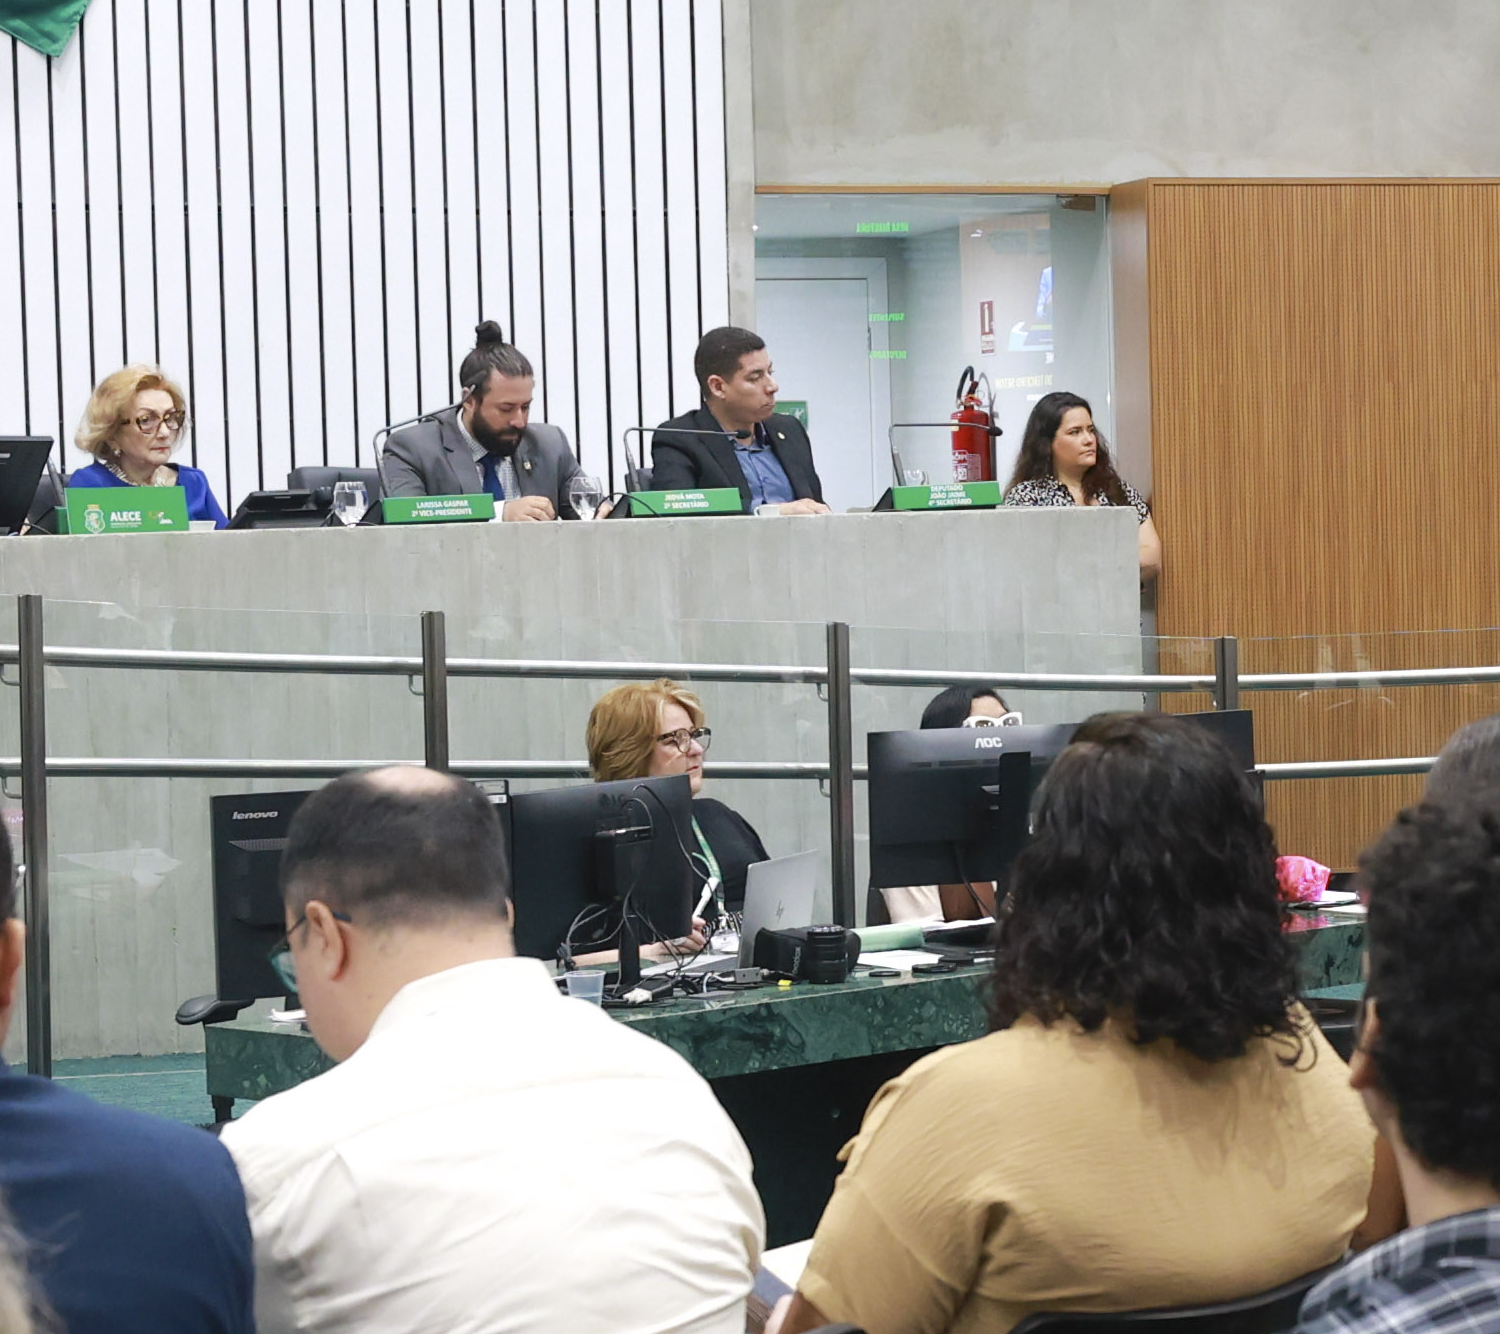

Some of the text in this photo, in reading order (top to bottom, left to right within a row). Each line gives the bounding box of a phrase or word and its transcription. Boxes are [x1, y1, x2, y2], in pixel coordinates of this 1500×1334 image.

[443, 500, 469, 508] GASPAR
[110, 511, 142, 522] ALECE
[975, 737, 1002, 748] AOC
[232, 811, 278, 820] lenovo
